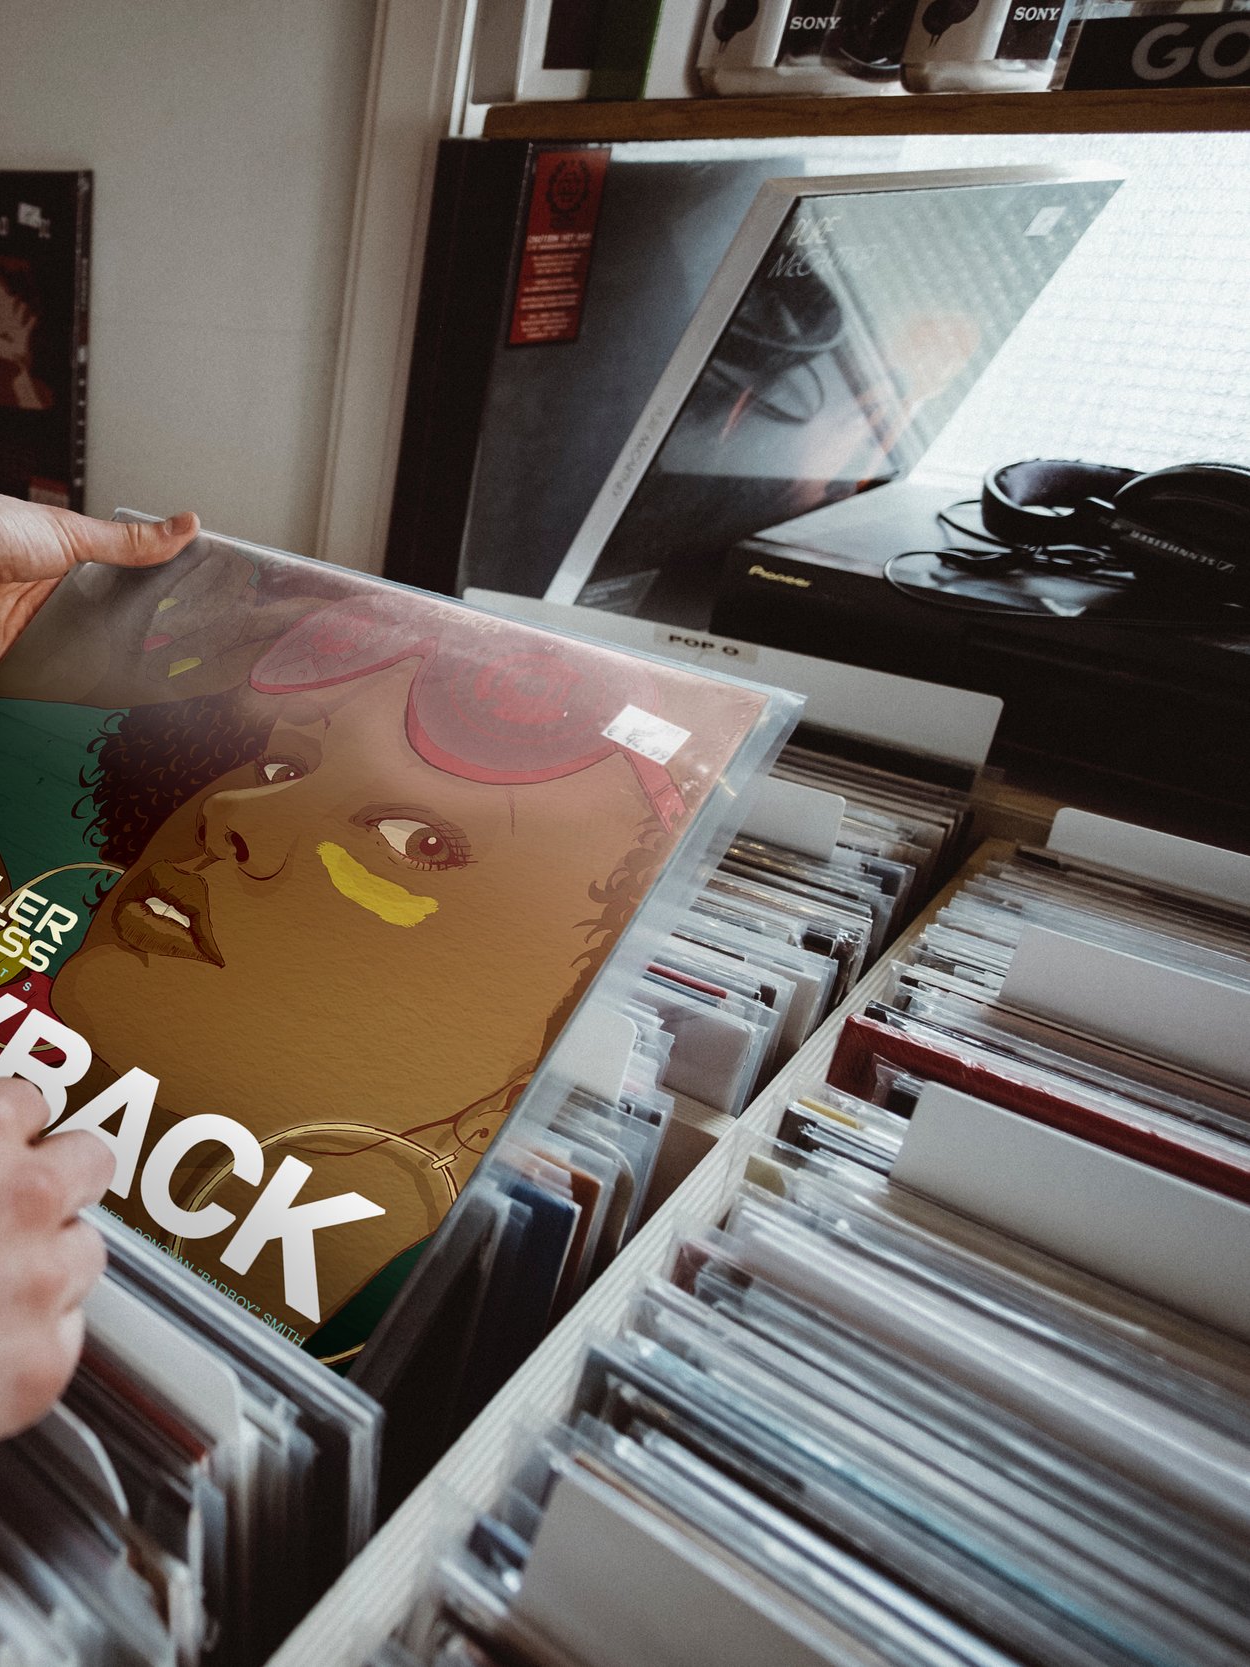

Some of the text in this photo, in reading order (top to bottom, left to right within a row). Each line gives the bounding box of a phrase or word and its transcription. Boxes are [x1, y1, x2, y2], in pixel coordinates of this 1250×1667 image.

[1013, 6, 1061, 21] SONY
[789, 16, 841, 30] SONY
[669, 635, 715, 649] POP
[261, 1313, 306, 1348] SMITH
